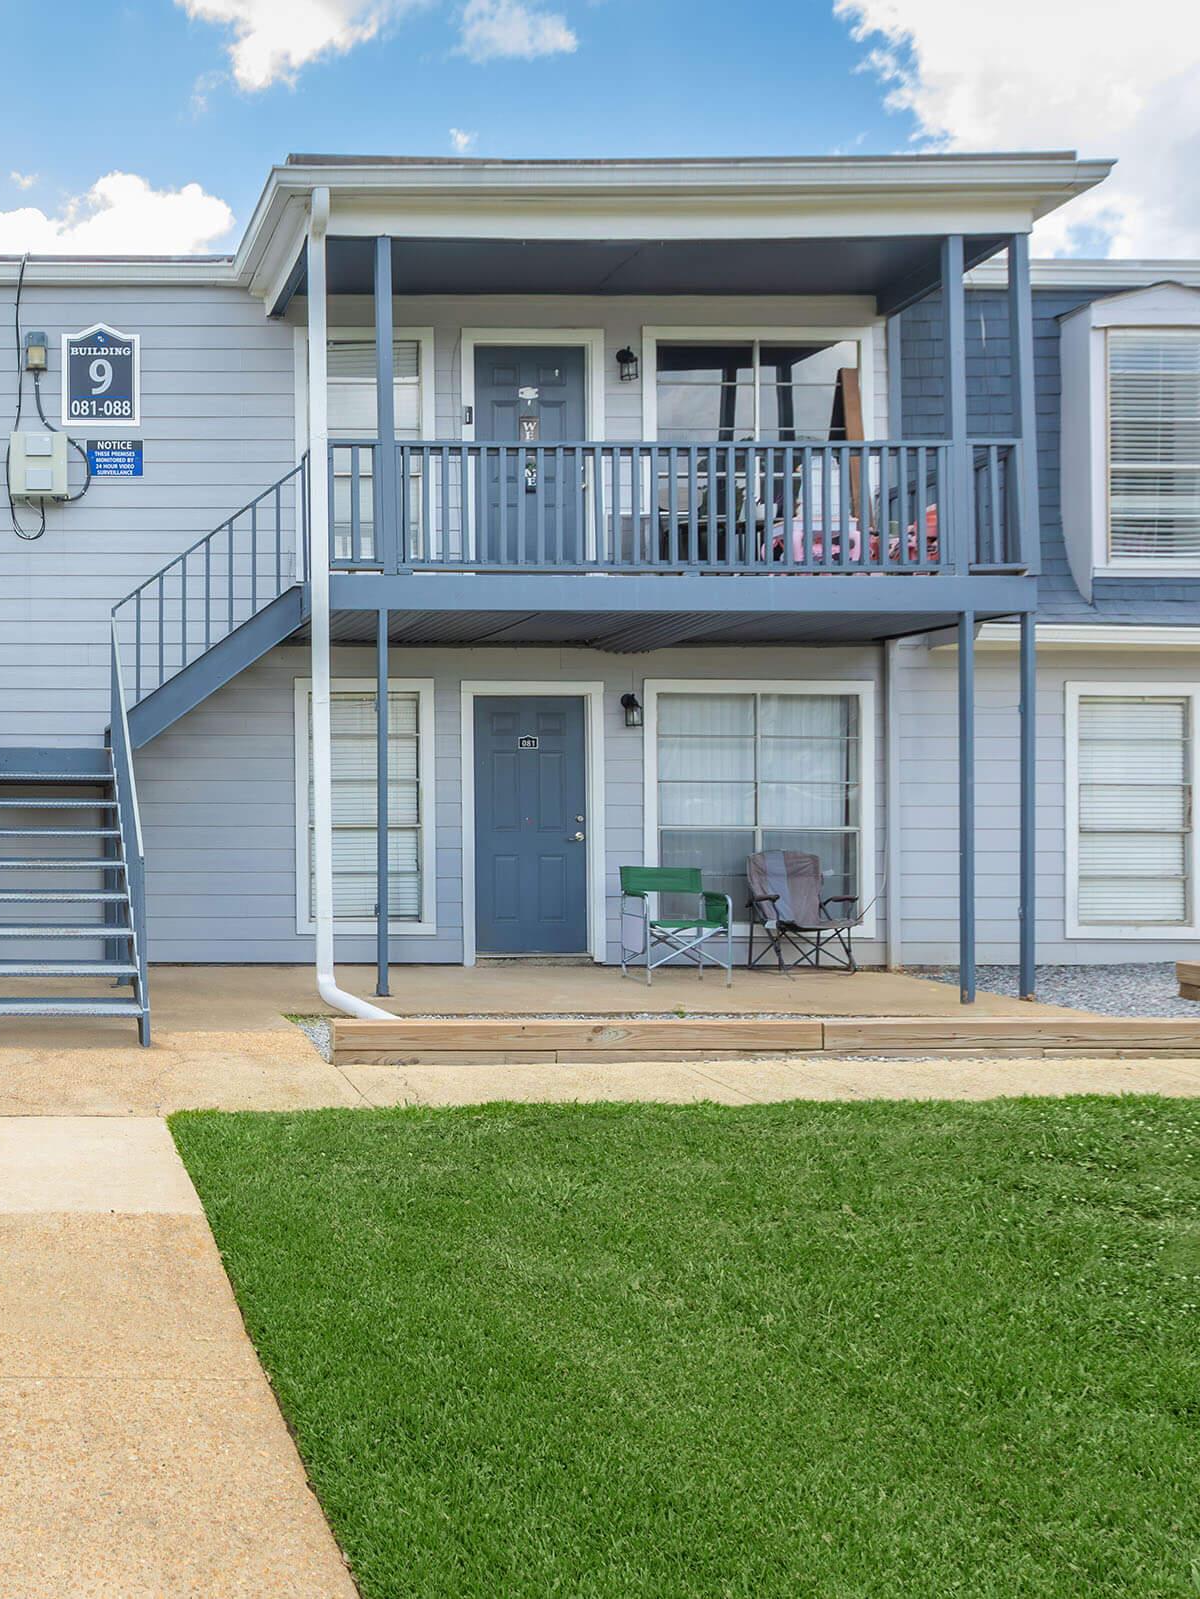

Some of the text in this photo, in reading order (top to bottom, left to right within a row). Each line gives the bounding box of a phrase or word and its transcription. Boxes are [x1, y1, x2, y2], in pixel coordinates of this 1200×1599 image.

[70, 347, 132, 356] BUILDING
[89, 358, 113, 395] 9
[71, 400, 131, 416] 081-088
[97, 441, 132, 450] NOTICE
[521, 739, 535, 747] 081
